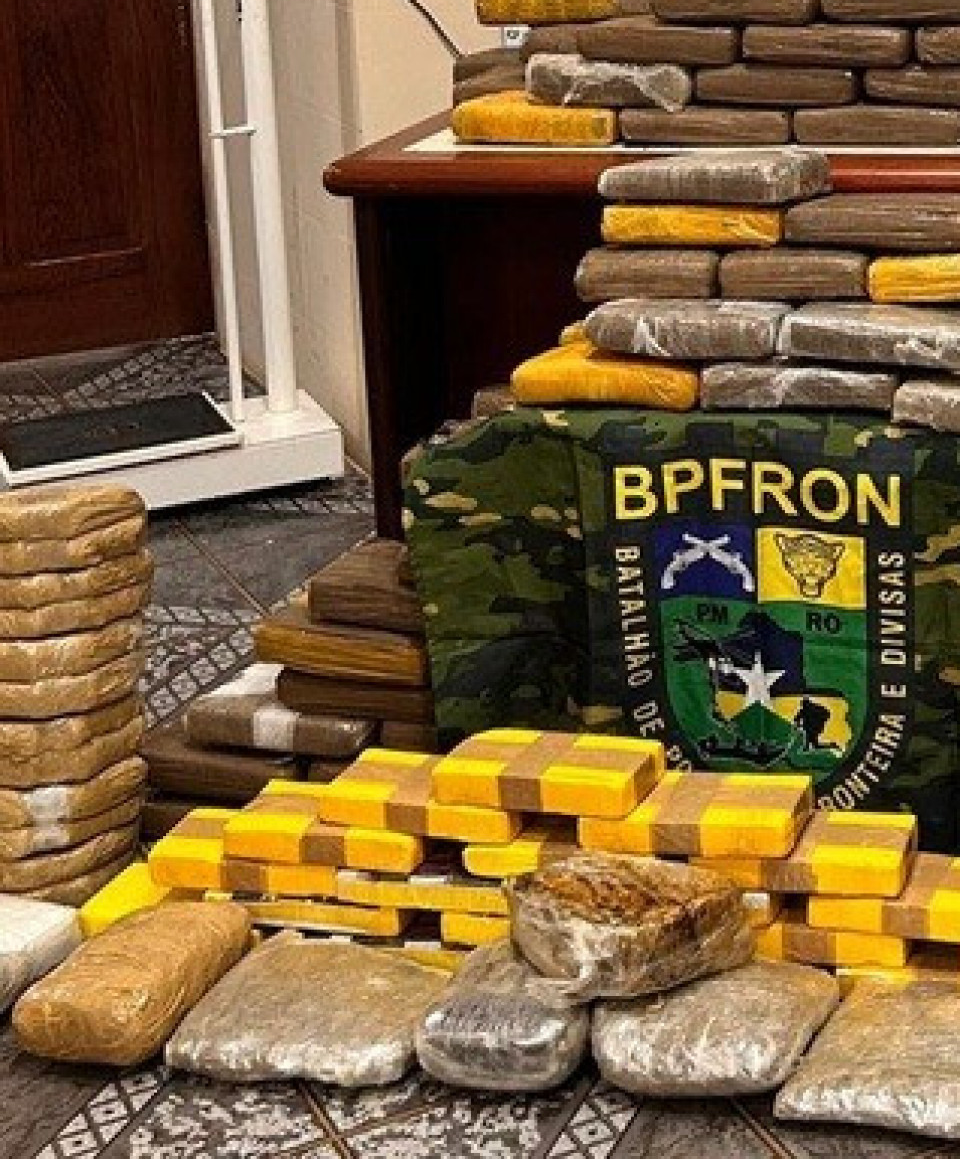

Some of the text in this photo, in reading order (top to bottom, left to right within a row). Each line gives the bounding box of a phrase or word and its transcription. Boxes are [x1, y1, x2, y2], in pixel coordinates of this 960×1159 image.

[614, 459, 901, 526] BPFRON
[615, 545, 665, 737] BATALHÃO DE
[697, 603, 842, 634] PM RO
[816, 551, 907, 812] RONTEIRA E DIVISAS
